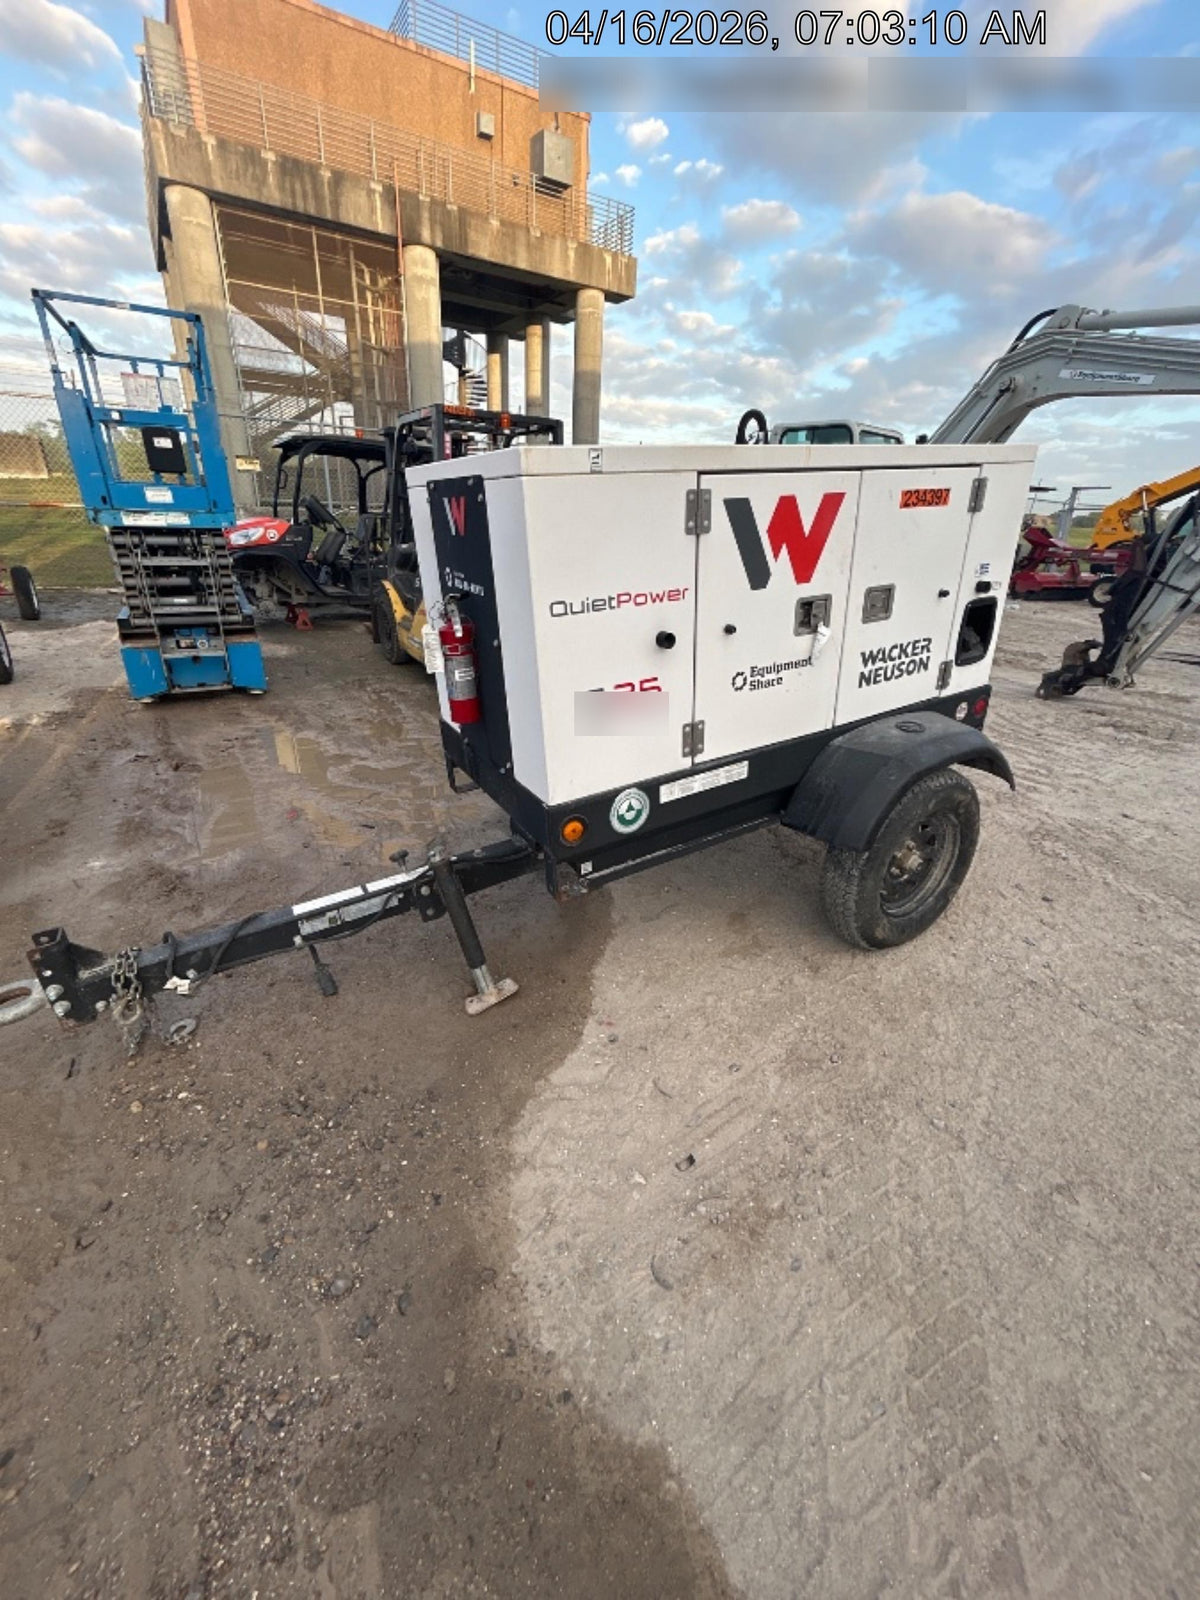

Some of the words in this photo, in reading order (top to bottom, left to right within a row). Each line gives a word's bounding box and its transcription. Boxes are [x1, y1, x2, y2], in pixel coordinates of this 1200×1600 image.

[902, 488, 951, 507] 234397
[549, 588, 689, 618] QuietPower
[860, 637, 933, 669] WACKER
[750, 655, 814, 678] Equipment
[858, 655, 931, 689] NEUSON
[748, 676, 784, 691] Share
